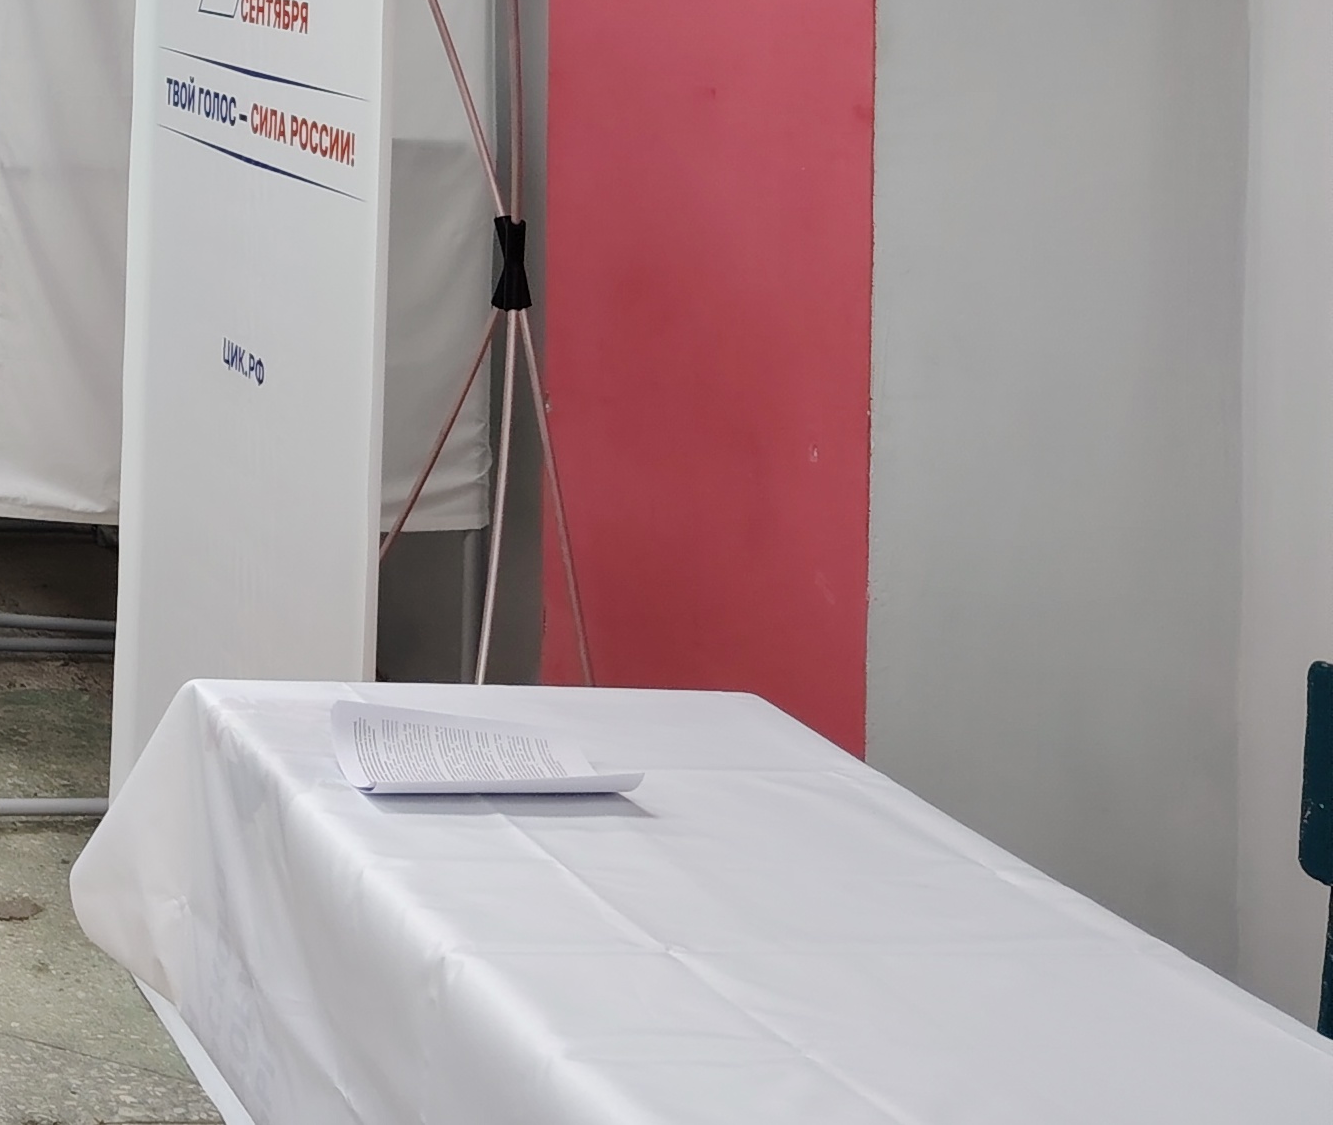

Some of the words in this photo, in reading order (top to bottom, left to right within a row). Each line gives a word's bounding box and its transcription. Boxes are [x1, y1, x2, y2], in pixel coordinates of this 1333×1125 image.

[166, 76, 196, 114] ТВОЙ
[198, 87, 237, 127] ГОЛОС
[251, 103, 287, 144] СИЛА
[290, 114, 355, 167] РОССИИ!
[223, 336, 264, 386] ЦИК.РФ
